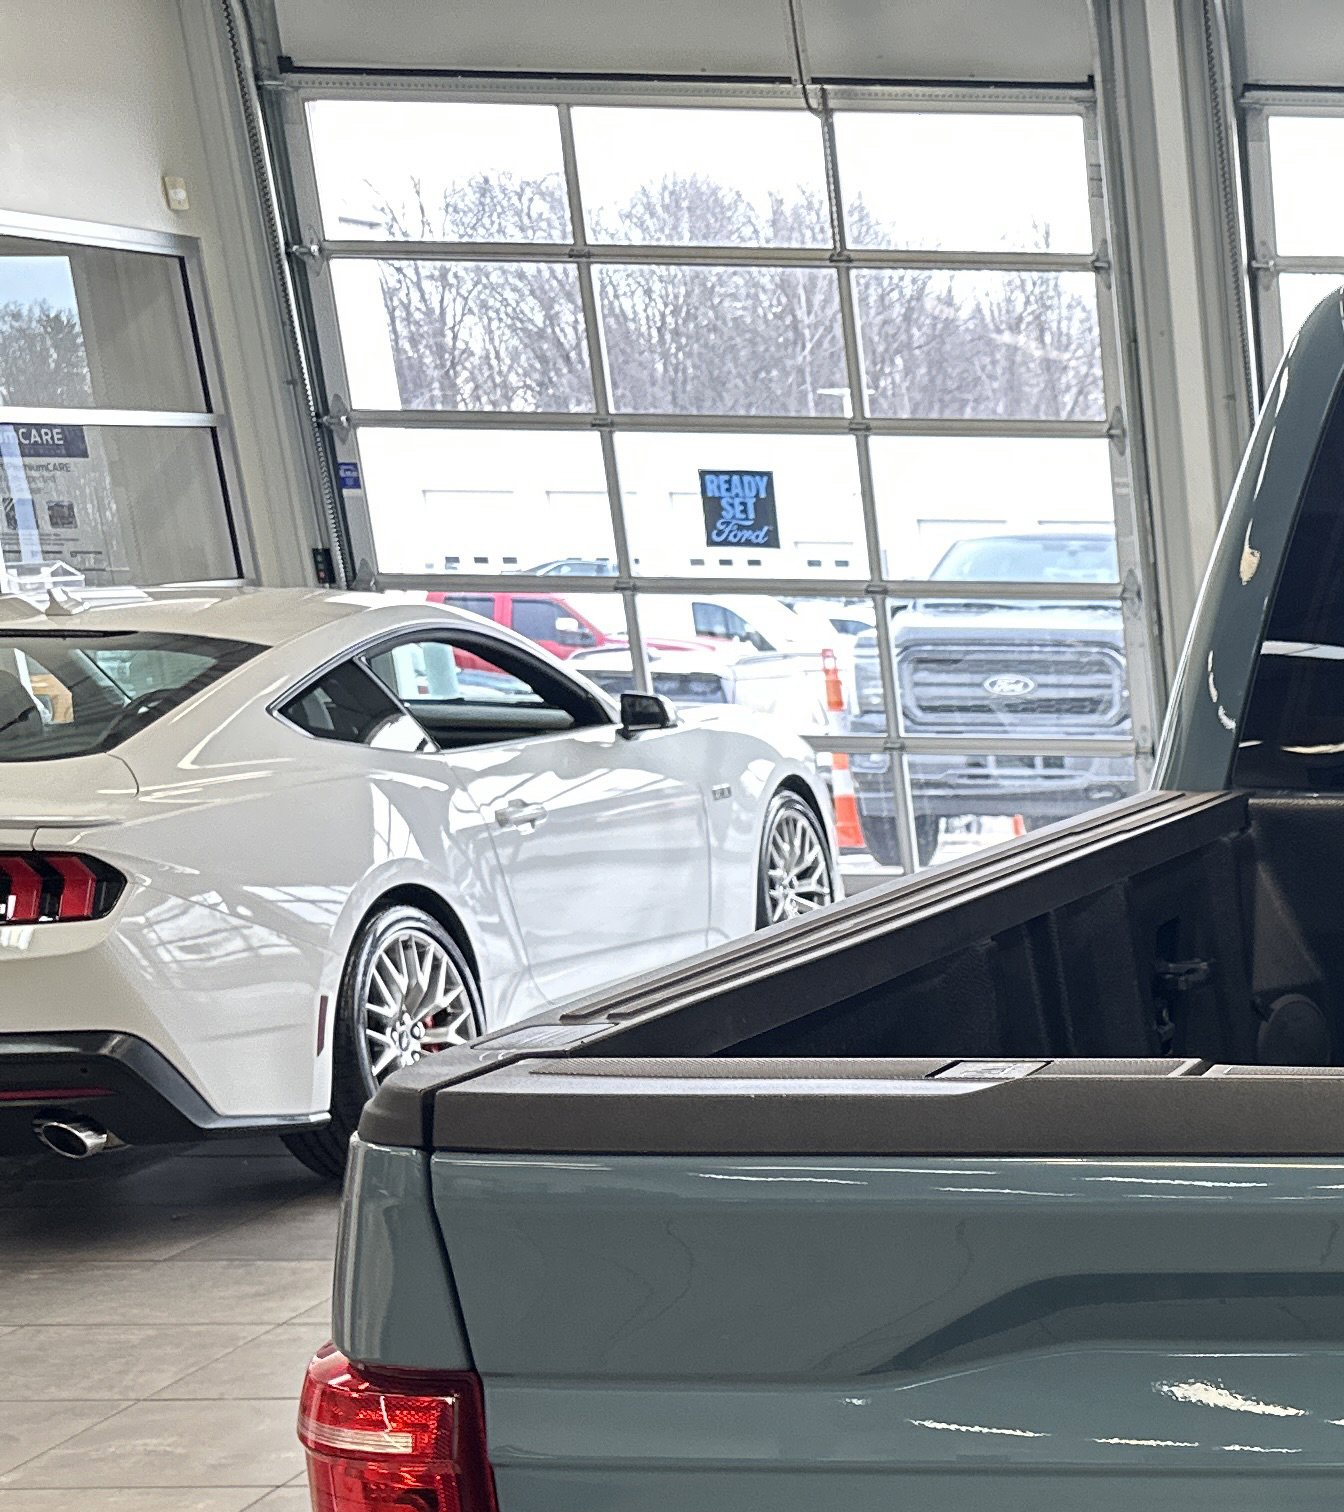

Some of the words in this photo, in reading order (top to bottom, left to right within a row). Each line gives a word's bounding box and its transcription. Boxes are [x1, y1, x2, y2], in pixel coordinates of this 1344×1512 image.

[705, 475, 768, 498] READY
[720, 497, 756, 519] SET
[711, 519, 769, 543] Ford
